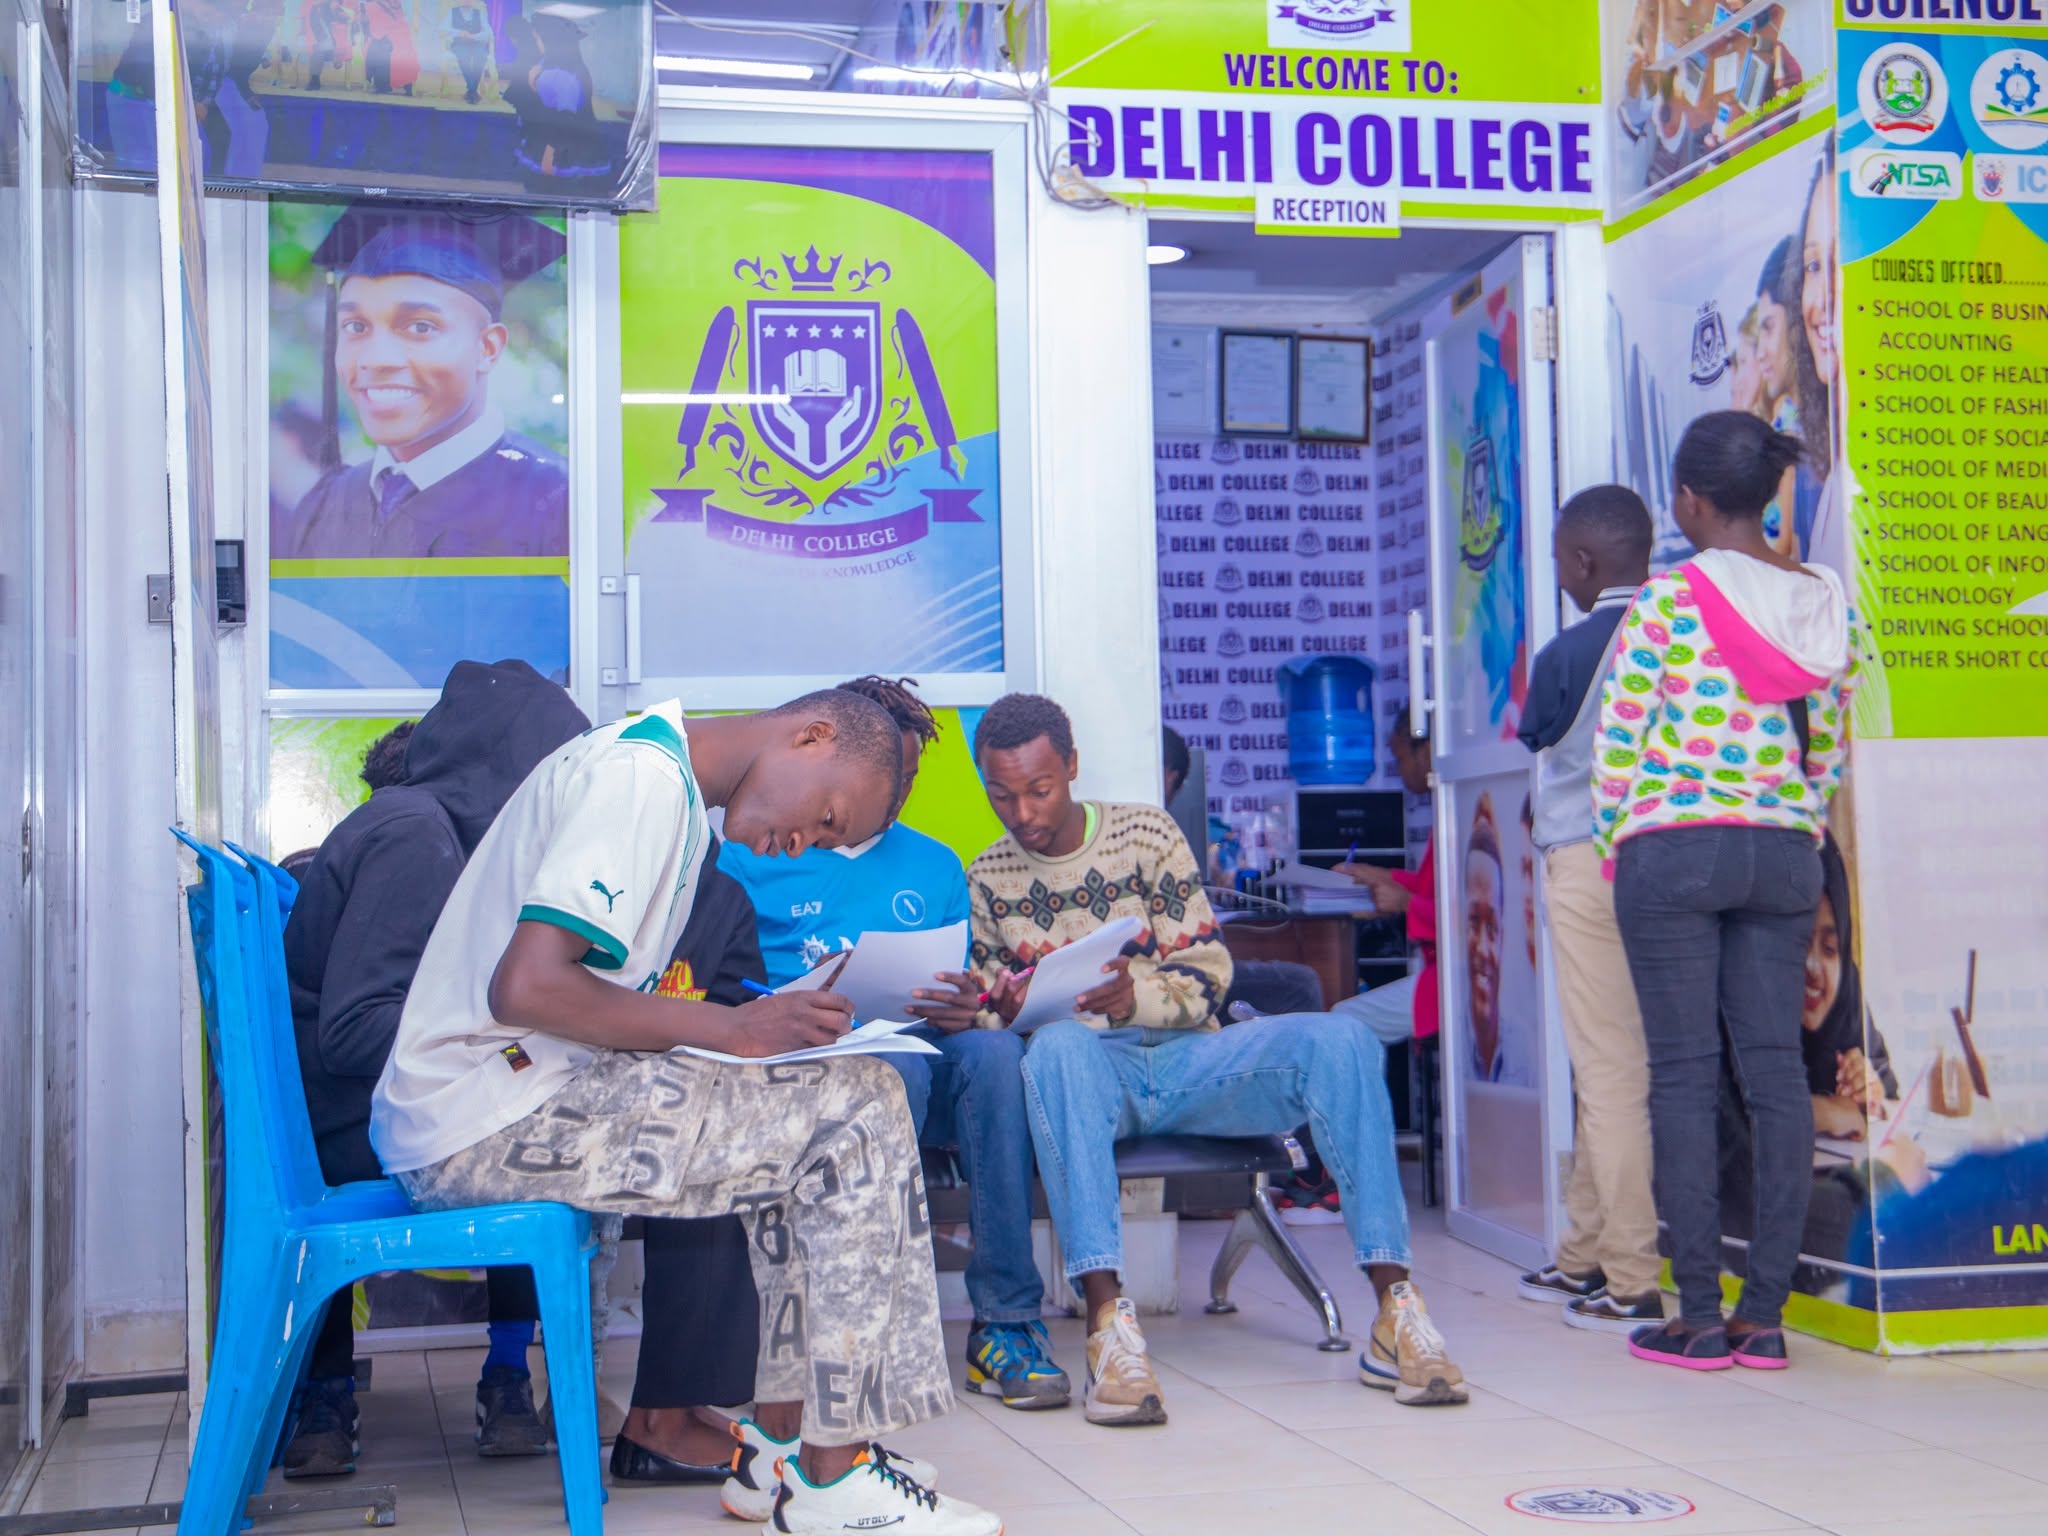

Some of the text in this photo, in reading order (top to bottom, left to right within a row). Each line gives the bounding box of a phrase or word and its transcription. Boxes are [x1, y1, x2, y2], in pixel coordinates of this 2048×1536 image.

[1223, 53, 1459, 94] WELCOME TO:
[1067, 104, 1593, 194] DELHI COLLEGE
[1880, 162, 1951, 187] NTSA
[1273, 197, 1386, 225] RECEPTION
[1872, 258, 1935, 284] COURSES
[1873, 299, 2048, 320] SCHOOL OF BUSIN
[1879, 331, 2013, 352] ACCOUNTING
[1874, 363, 1953, 382] SCHOOL
[1960, 365, 1987, 383] OF
[1875, 396, 2048, 415] SCHOOL OF FASHI
[1876, 427, 1956, 445] SCHOOL
[1962, 429, 1987, 446] OF
[1876, 459, 1957, 476] SCHOOL
[1963, 461, 1989, 477] OF
[1222, 474, 1288, 491] COLLEGE
[1877, 491, 2048, 510] SCHOOL OF BEAU
[1297, 504, 1363, 521] COLLEGE
[730, 524, 898, 552] DELHI COLLEGE
[1878, 523, 2048, 542] SCHOOL OF LANG
[1223, 536, 1289, 552] COLLEGE
[1879, 555, 2048, 574] SCHOOL OF INFO
[1300, 571, 1365, 588] COLLEGE
[1880, 586, 2015, 604] TECHNOLOGY
[1225, 602, 1292, 619] COLLEGE
[1881, 618, 2048, 637] DRIVING SCHOOL
[1882, 650, 1950, 668] OTHER
[1955, 651, 2021, 668] SHORT
[791, 901, 823, 918] EA7
